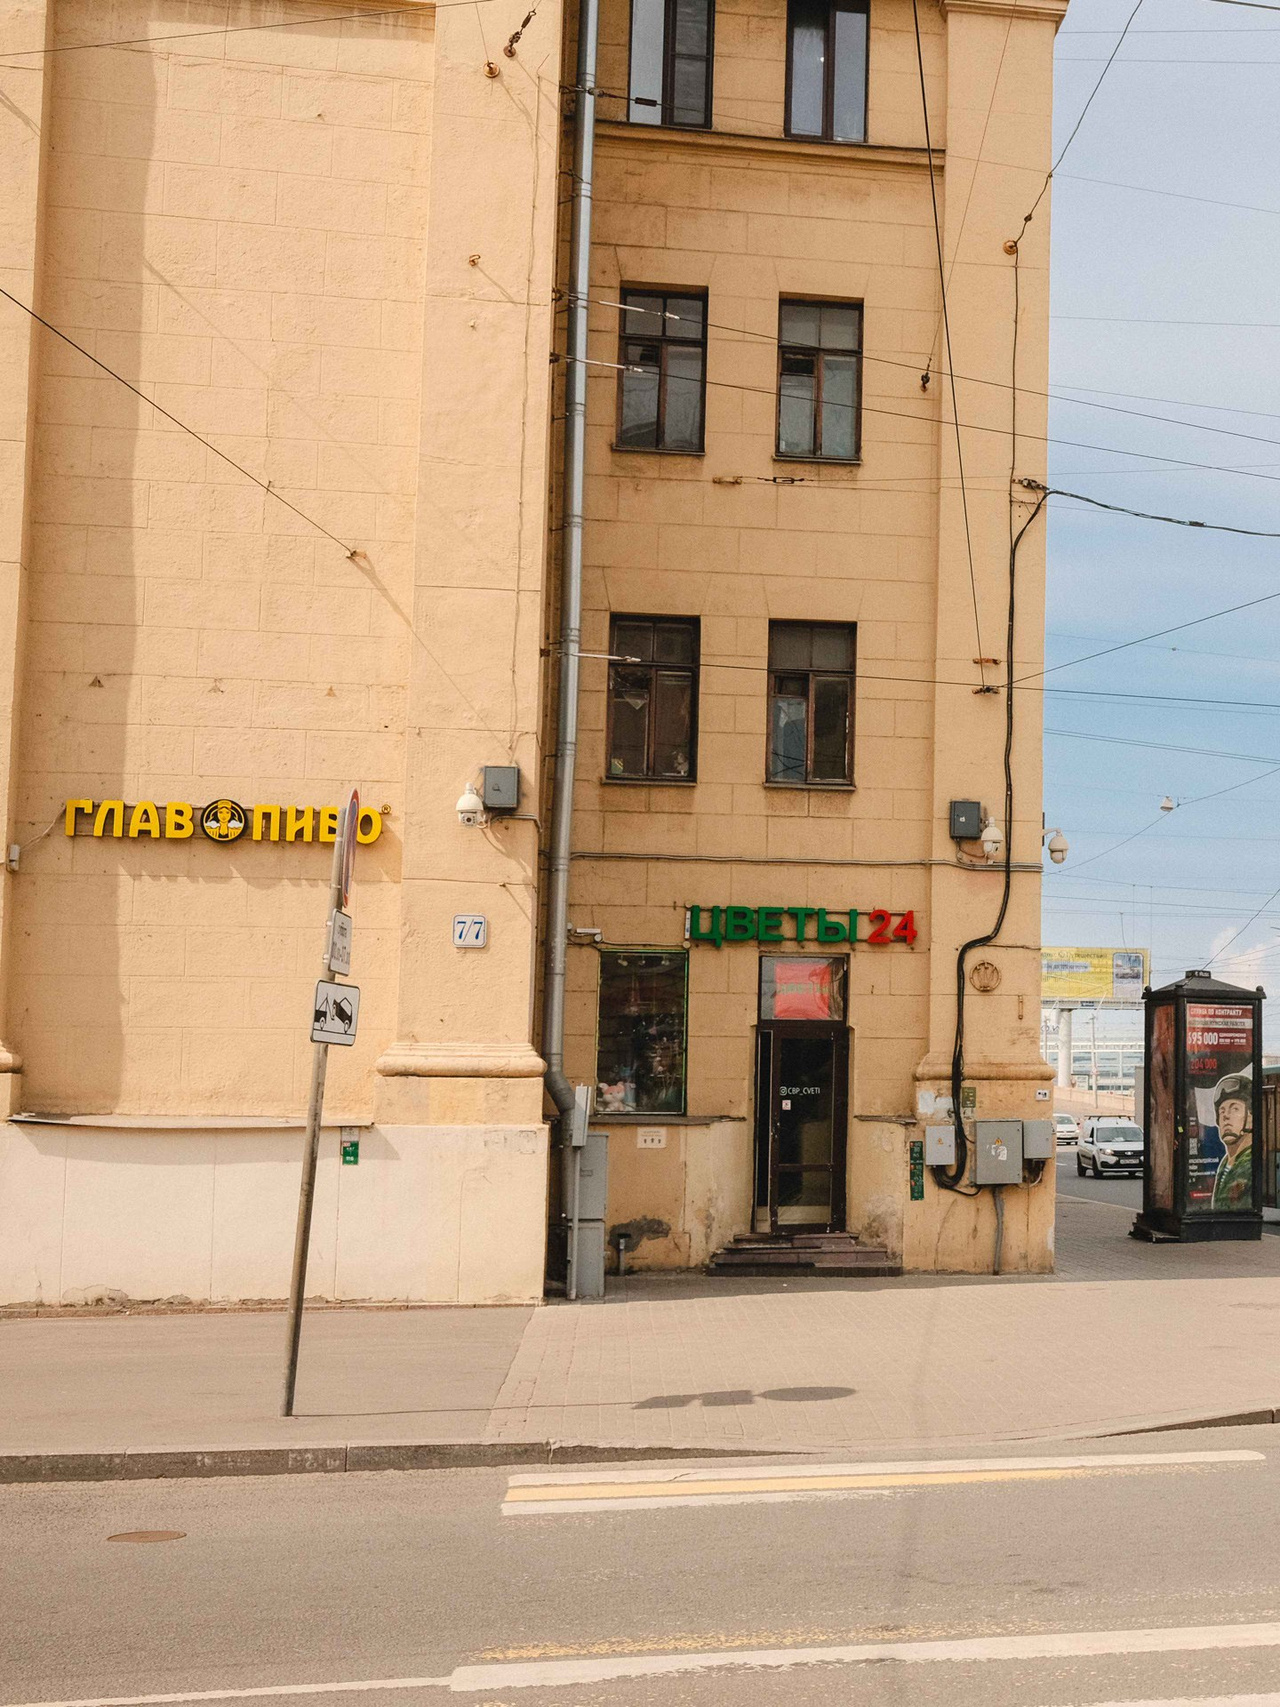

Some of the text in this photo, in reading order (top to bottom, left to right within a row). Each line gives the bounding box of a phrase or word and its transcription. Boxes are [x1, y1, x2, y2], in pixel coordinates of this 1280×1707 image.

[65, 799, 382, 844] ГЛАВ ПИВО
[456, 918, 484, 943] 7/7
[691, 904, 918, 948] ЦВЕТЫ 24
[1215, 1008, 1243, 1016] КОНТРАКТУ
